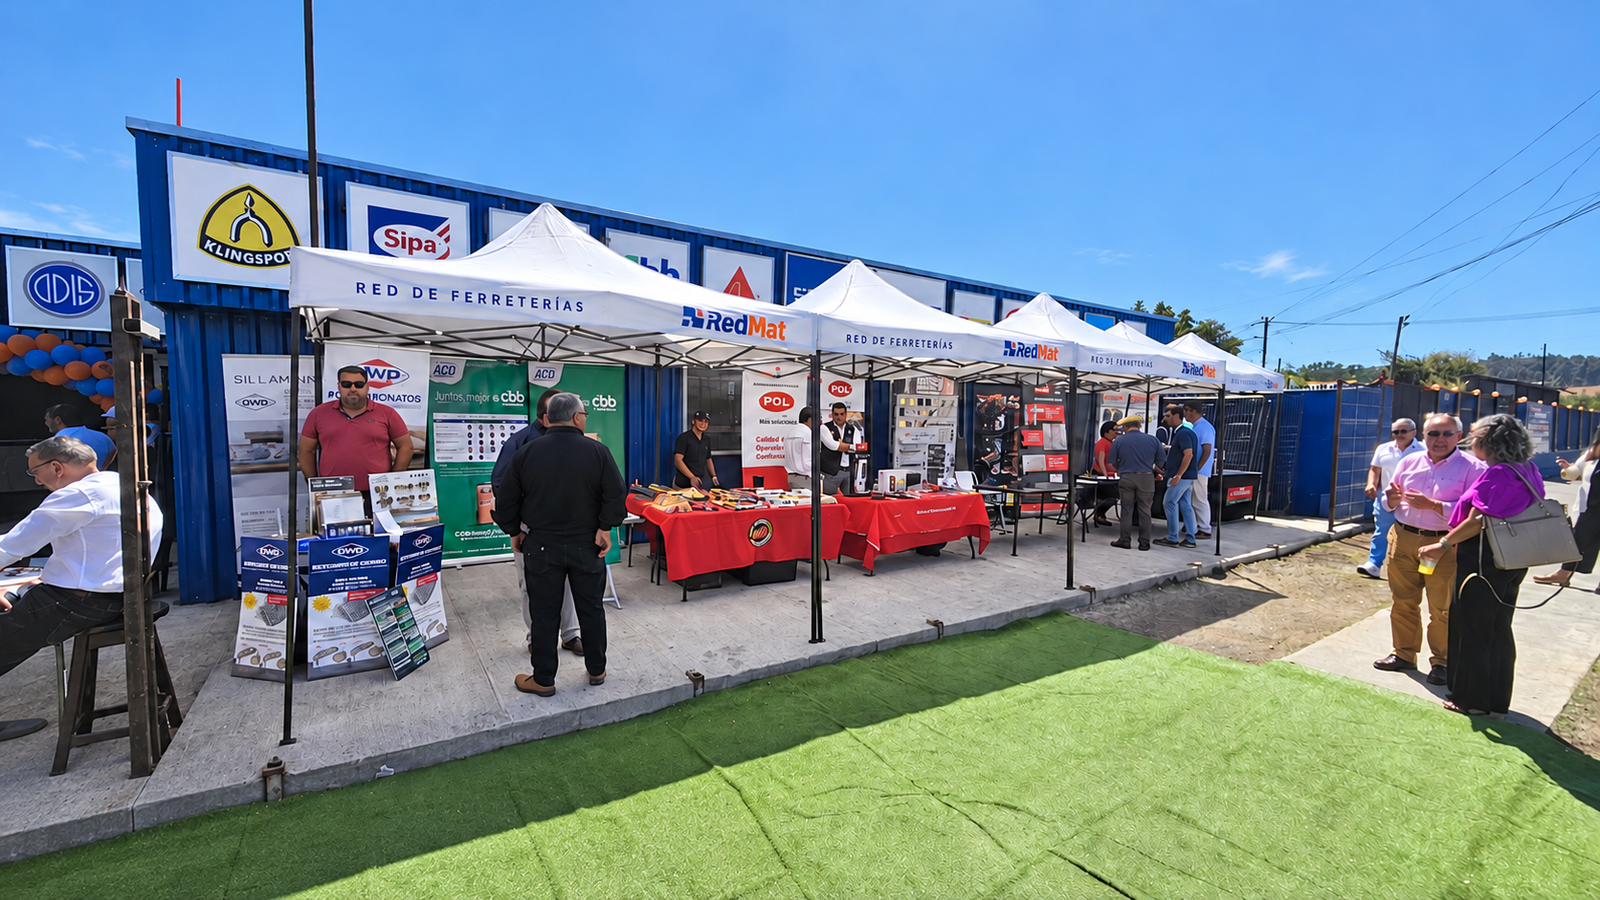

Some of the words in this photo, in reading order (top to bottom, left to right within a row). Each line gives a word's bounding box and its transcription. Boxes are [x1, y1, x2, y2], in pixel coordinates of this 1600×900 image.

[204, 239, 291, 264] KLINGSPOR
[384, 228, 437, 256] Sipa
[356, 282, 398, 297] RED
[412, 287, 438, 300] DE
[451, 291, 584, 312] FERRETERÍAS
[706, 310, 787, 341] RedMat
[846, 334, 867, 344] RED
[872, 336, 885, 345] DE
[889, 337, 953, 350] FERRETERÍAS
[1016, 341, 1059, 361] RedMat
[831, 385, 850, 394] POL
[763, 396, 790, 406] POL
